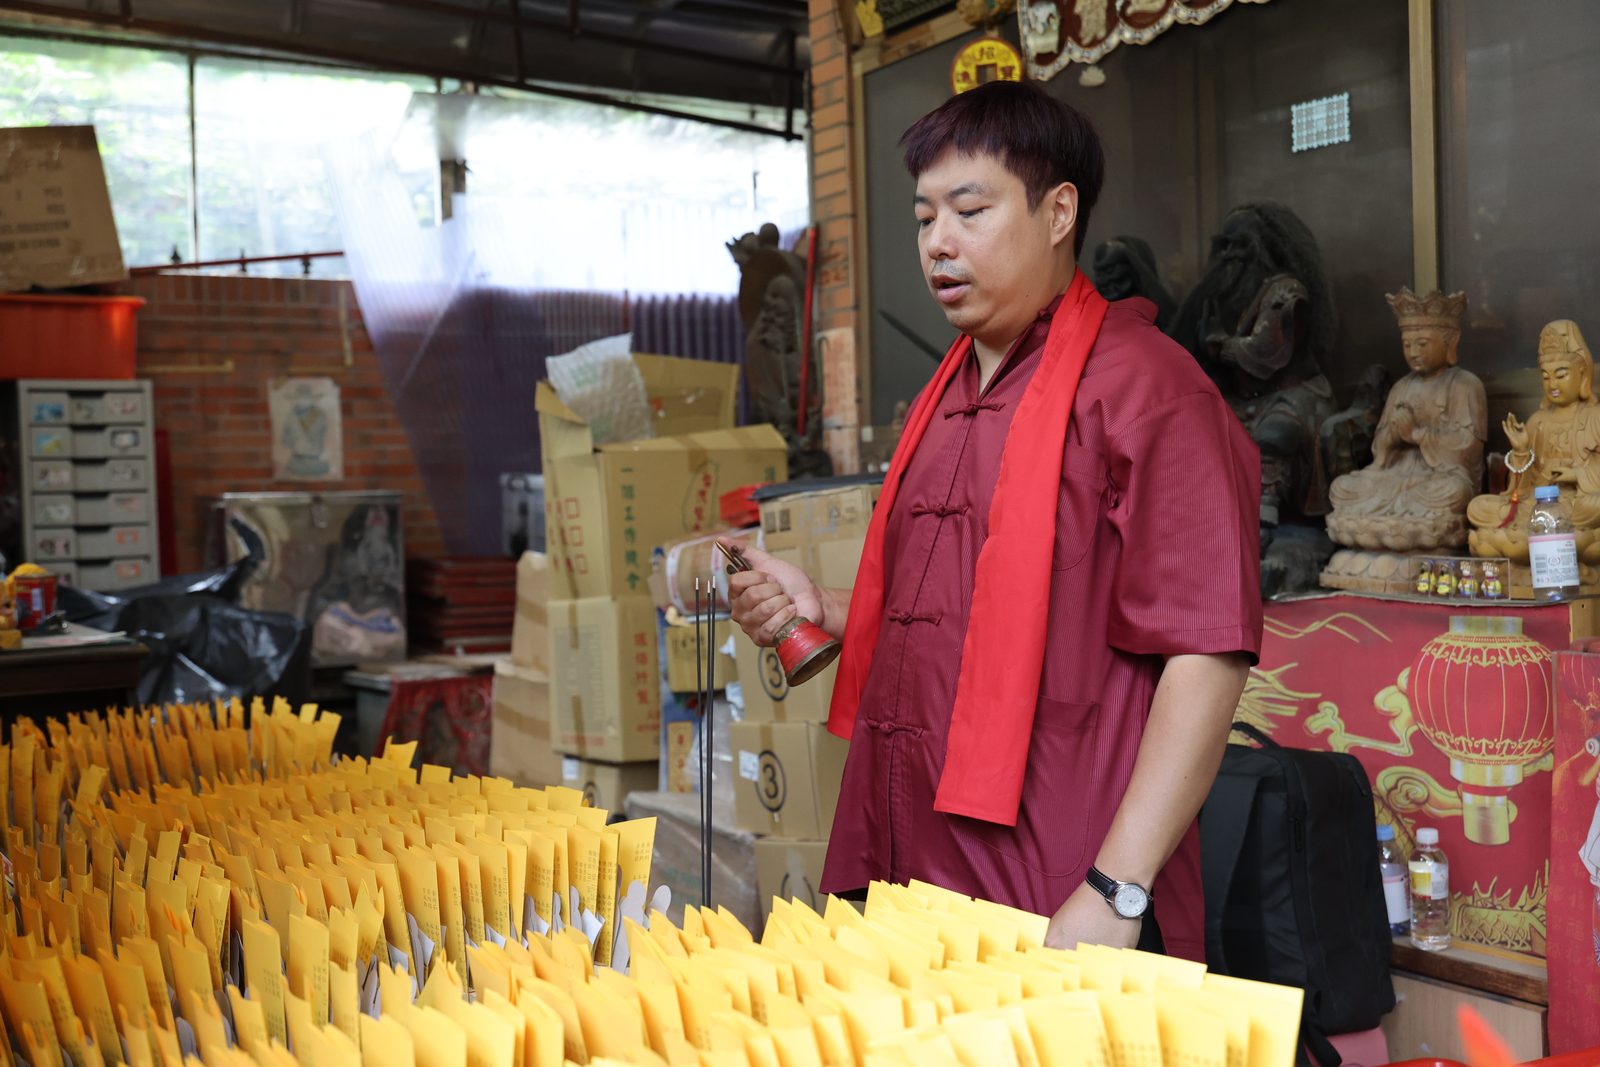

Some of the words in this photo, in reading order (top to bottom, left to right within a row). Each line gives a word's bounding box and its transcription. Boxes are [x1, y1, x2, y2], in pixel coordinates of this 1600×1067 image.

[979, 46, 995, 60] 招
[766, 653, 783, 688] 3
[762, 763, 779, 799] 3
